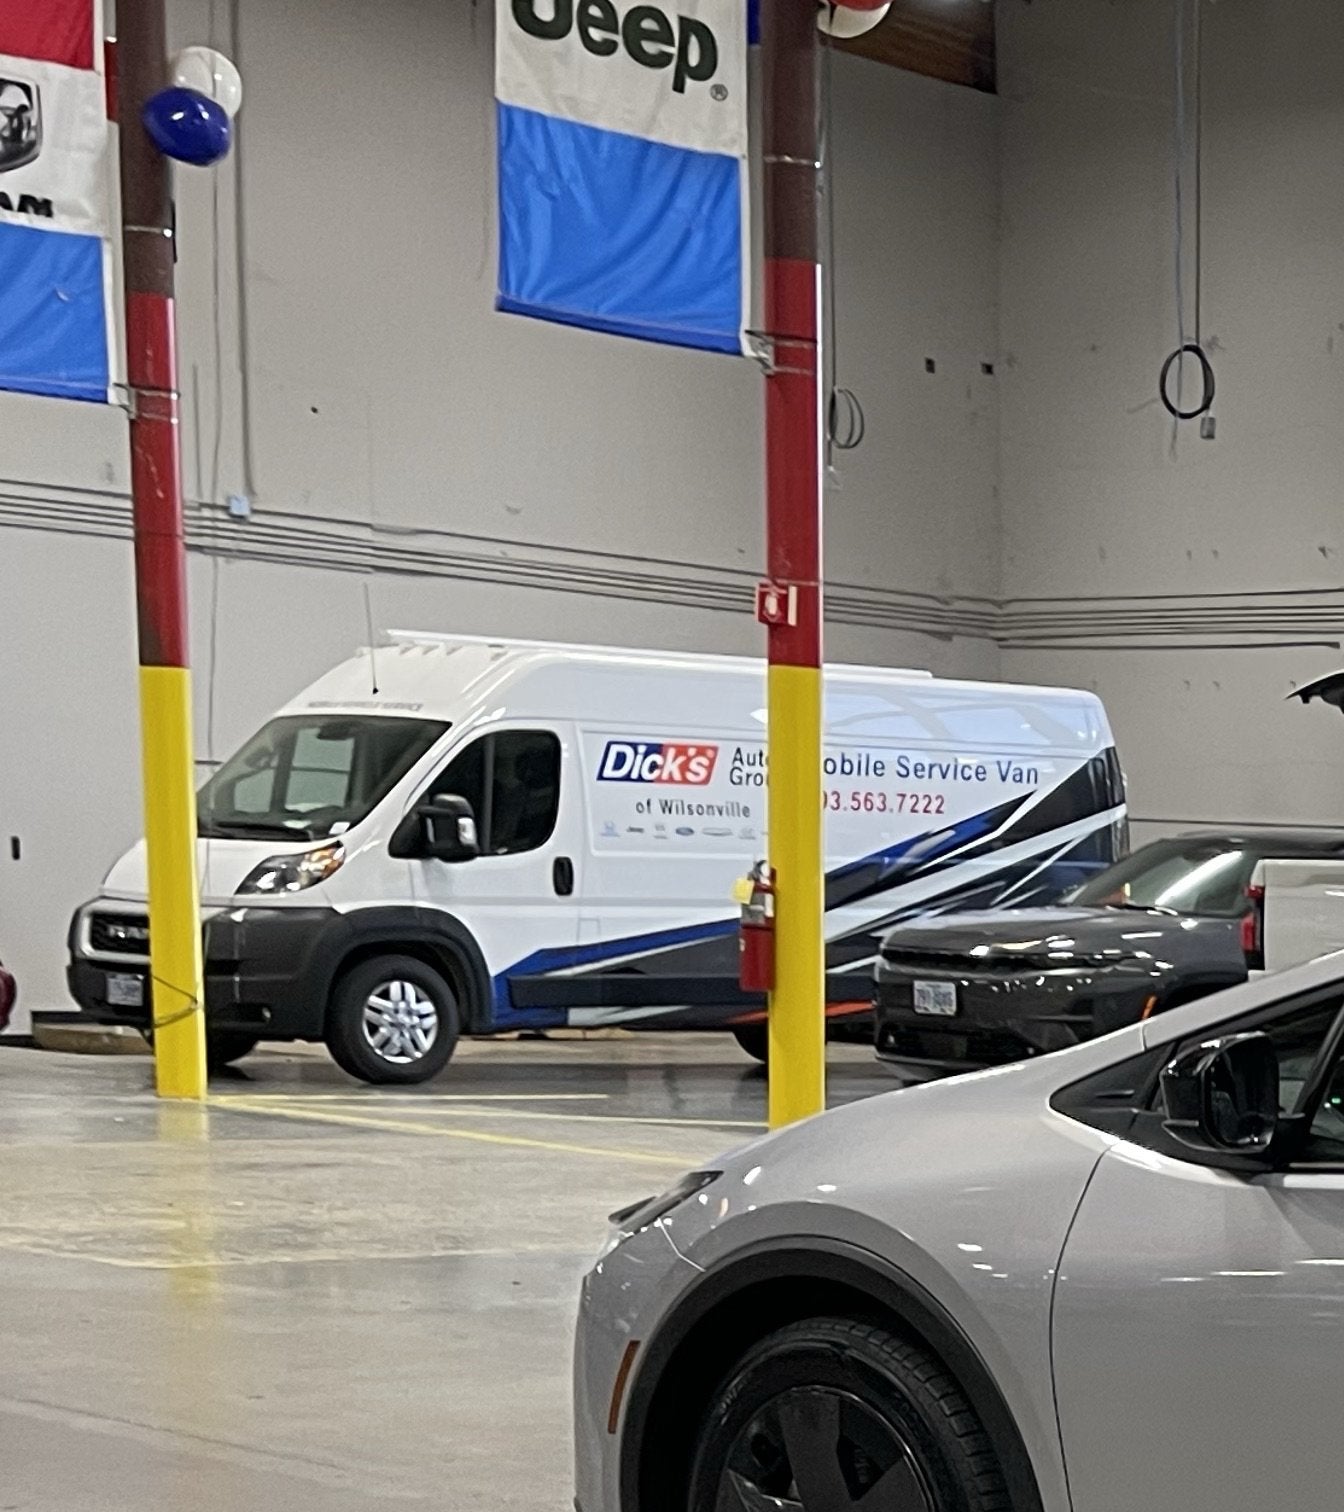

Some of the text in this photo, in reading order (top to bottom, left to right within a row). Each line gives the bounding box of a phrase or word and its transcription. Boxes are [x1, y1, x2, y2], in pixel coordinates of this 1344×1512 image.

[0, 192, 53, 218] AM
[602, 743, 711, 783] Dick's
[823, 752, 1039, 785] obile Service Van
[729, 766, 770, 787] Gro
[635, 798, 751, 818] of Wilsonville
[823, 790, 945, 815] 3.563.7222
